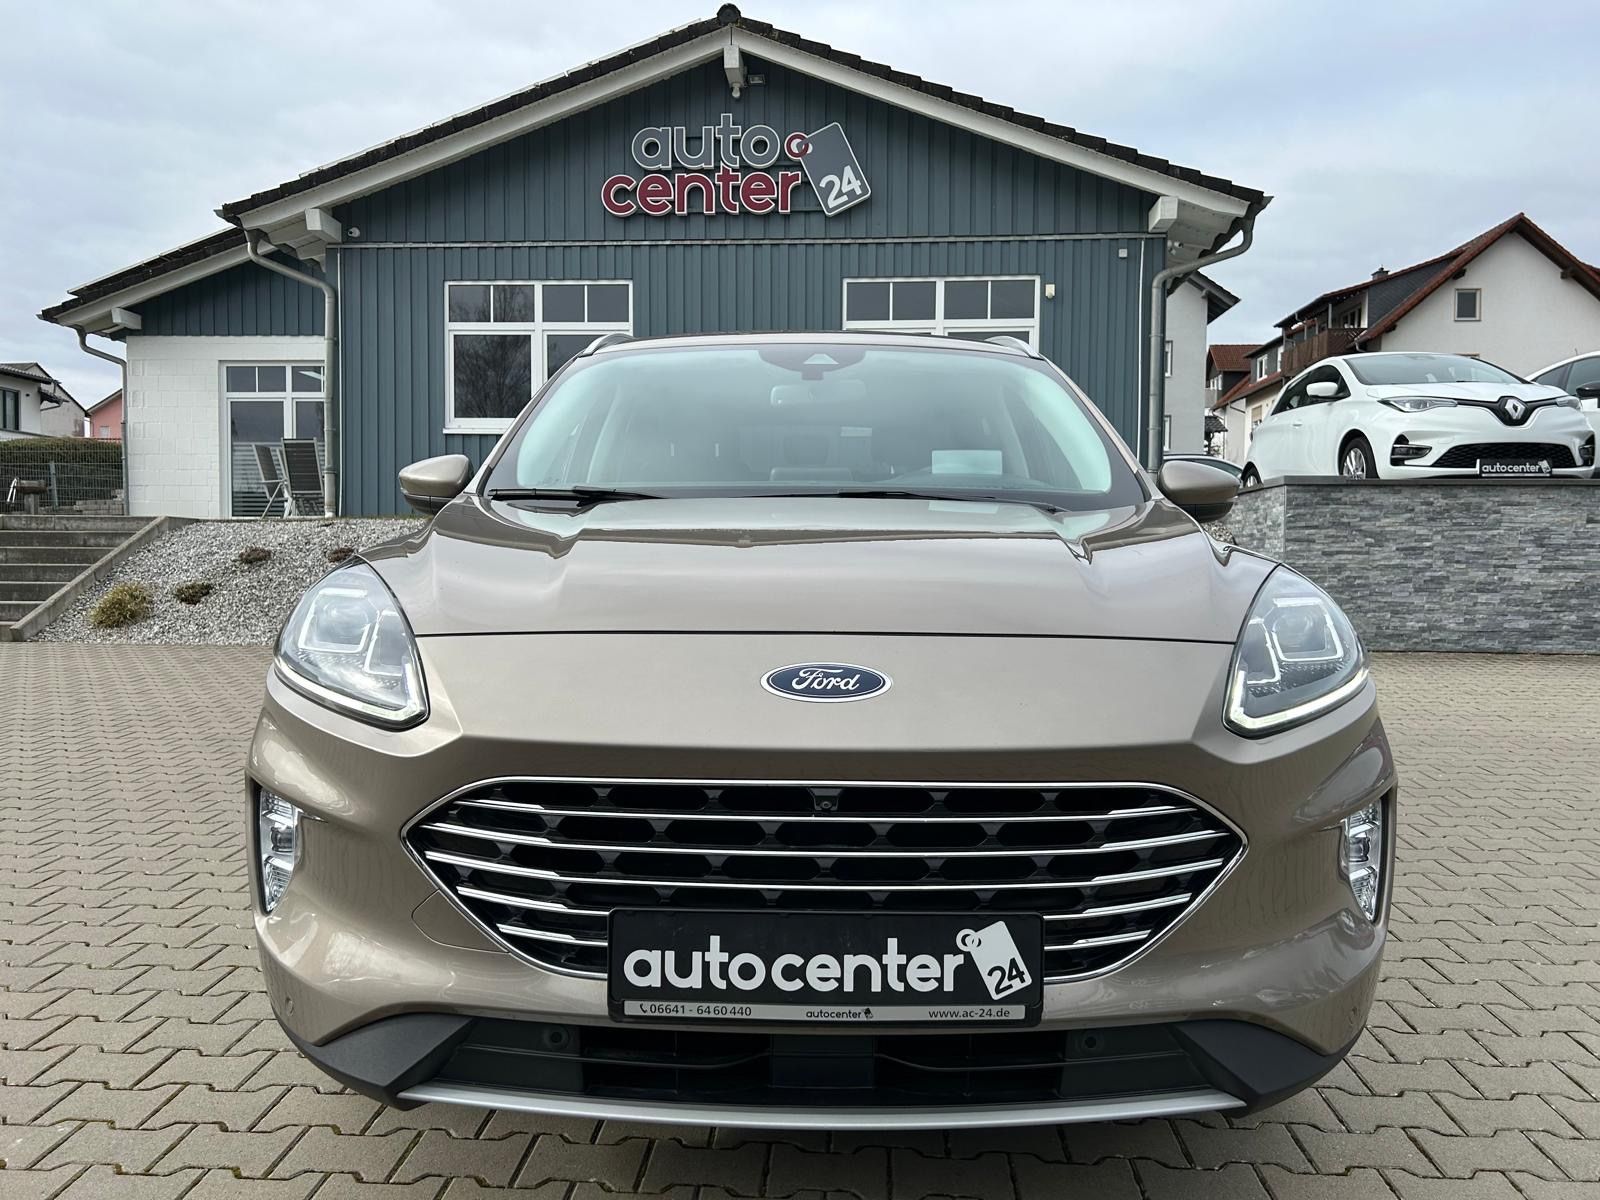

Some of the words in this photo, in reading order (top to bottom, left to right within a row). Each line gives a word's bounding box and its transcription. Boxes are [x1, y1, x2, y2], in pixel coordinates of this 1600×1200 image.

[631, 113, 780, 170] auto
[601, 161, 801, 216] center
[818, 164, 862, 209] 24
[1481, 462, 1540, 473] autocenter
[791, 667, 860, 691] Ford
[623, 935, 965, 993] autocenter
[987, 957, 1026, 996] 24
[649, 1003, 686, 1015] 06641
[805, 1008, 862, 1019] autocenter
[928, 1007, 1011, 1019] www.ac-24.de
